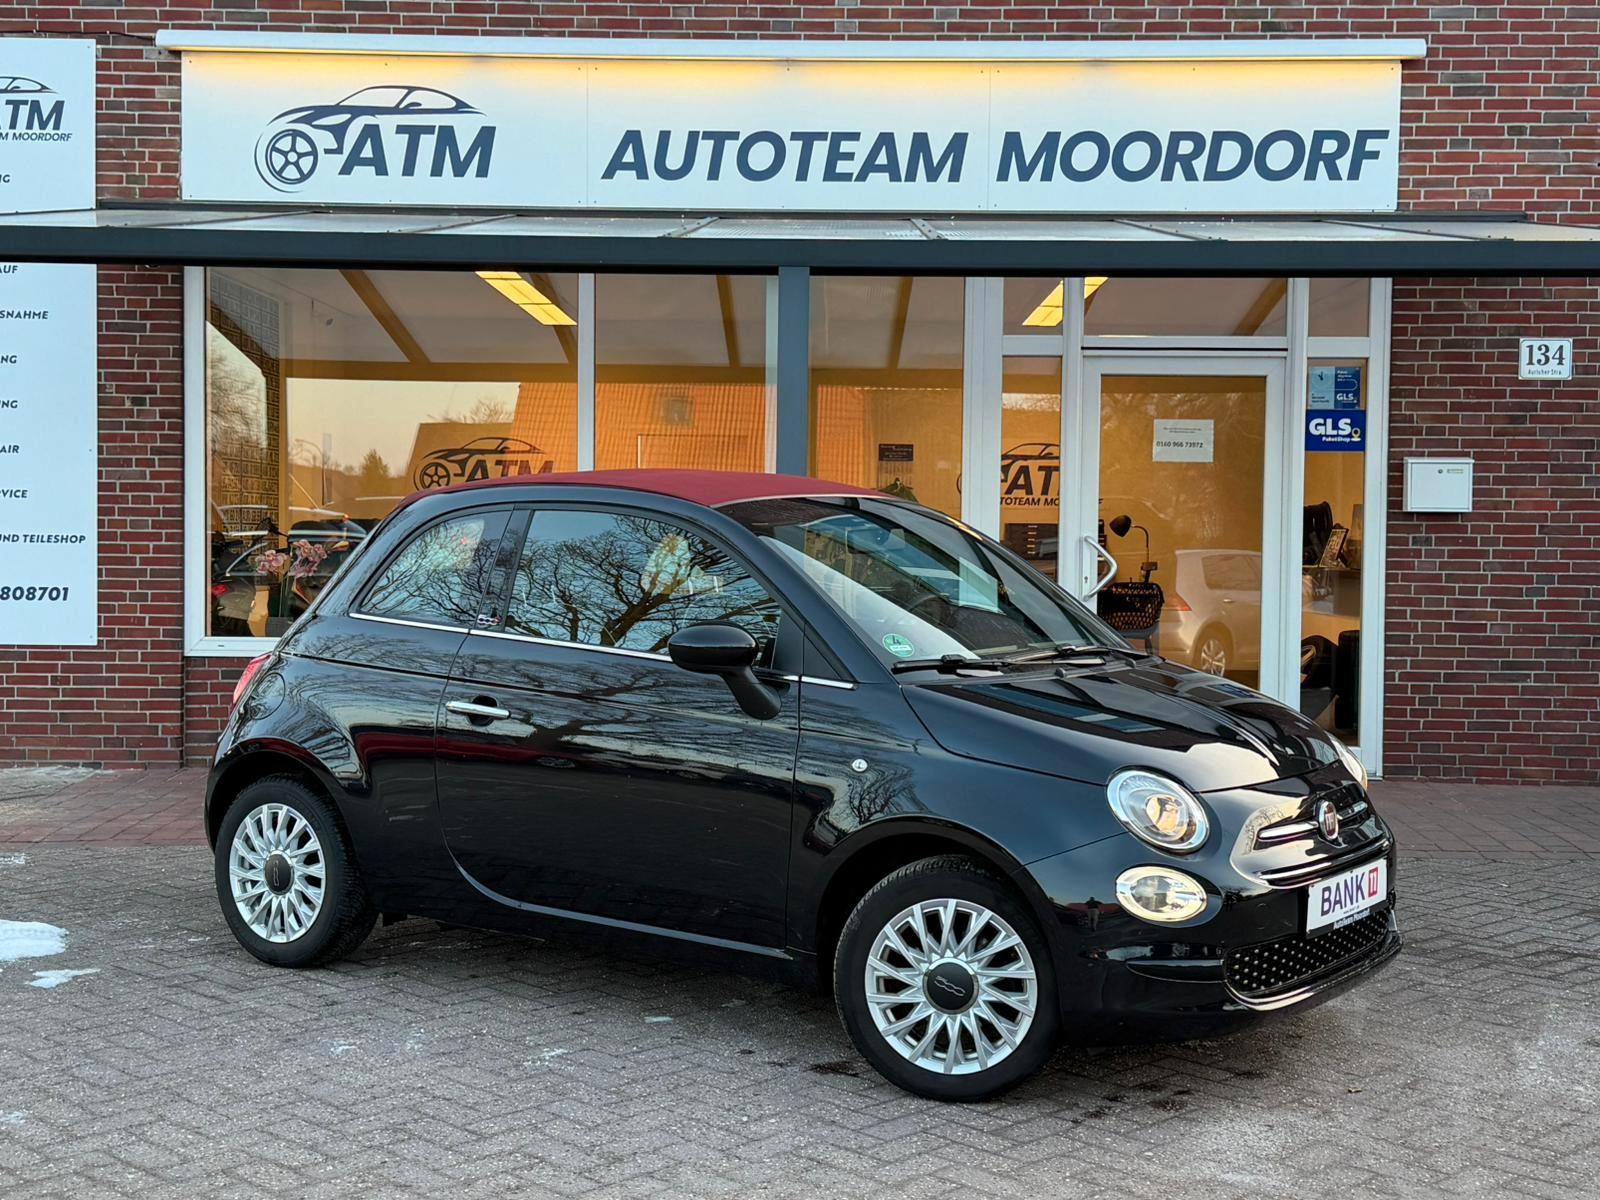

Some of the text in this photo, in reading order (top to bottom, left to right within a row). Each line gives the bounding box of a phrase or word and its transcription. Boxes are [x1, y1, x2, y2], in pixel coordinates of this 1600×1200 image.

[0, 99, 65, 131] TM
[12, 132, 72, 142] MOORDORF
[338, 124, 497, 178] ATM
[600, 129, 1390, 183] AUTOTEAM MOORDORF
[1525, 344, 1566, 366] 134
[0, 400, 18, 409] NG
[1336, 393, 1354, 401] GLS
[1309, 418, 1352, 436] GLS
[1004, 465, 1060, 496] AT
[0, 489, 28, 499] VICE
[22, 534, 86, 544] TEILESHOP
[0, 586, 69, 601] 808701
[1321, 871, 1366, 917] BANK
